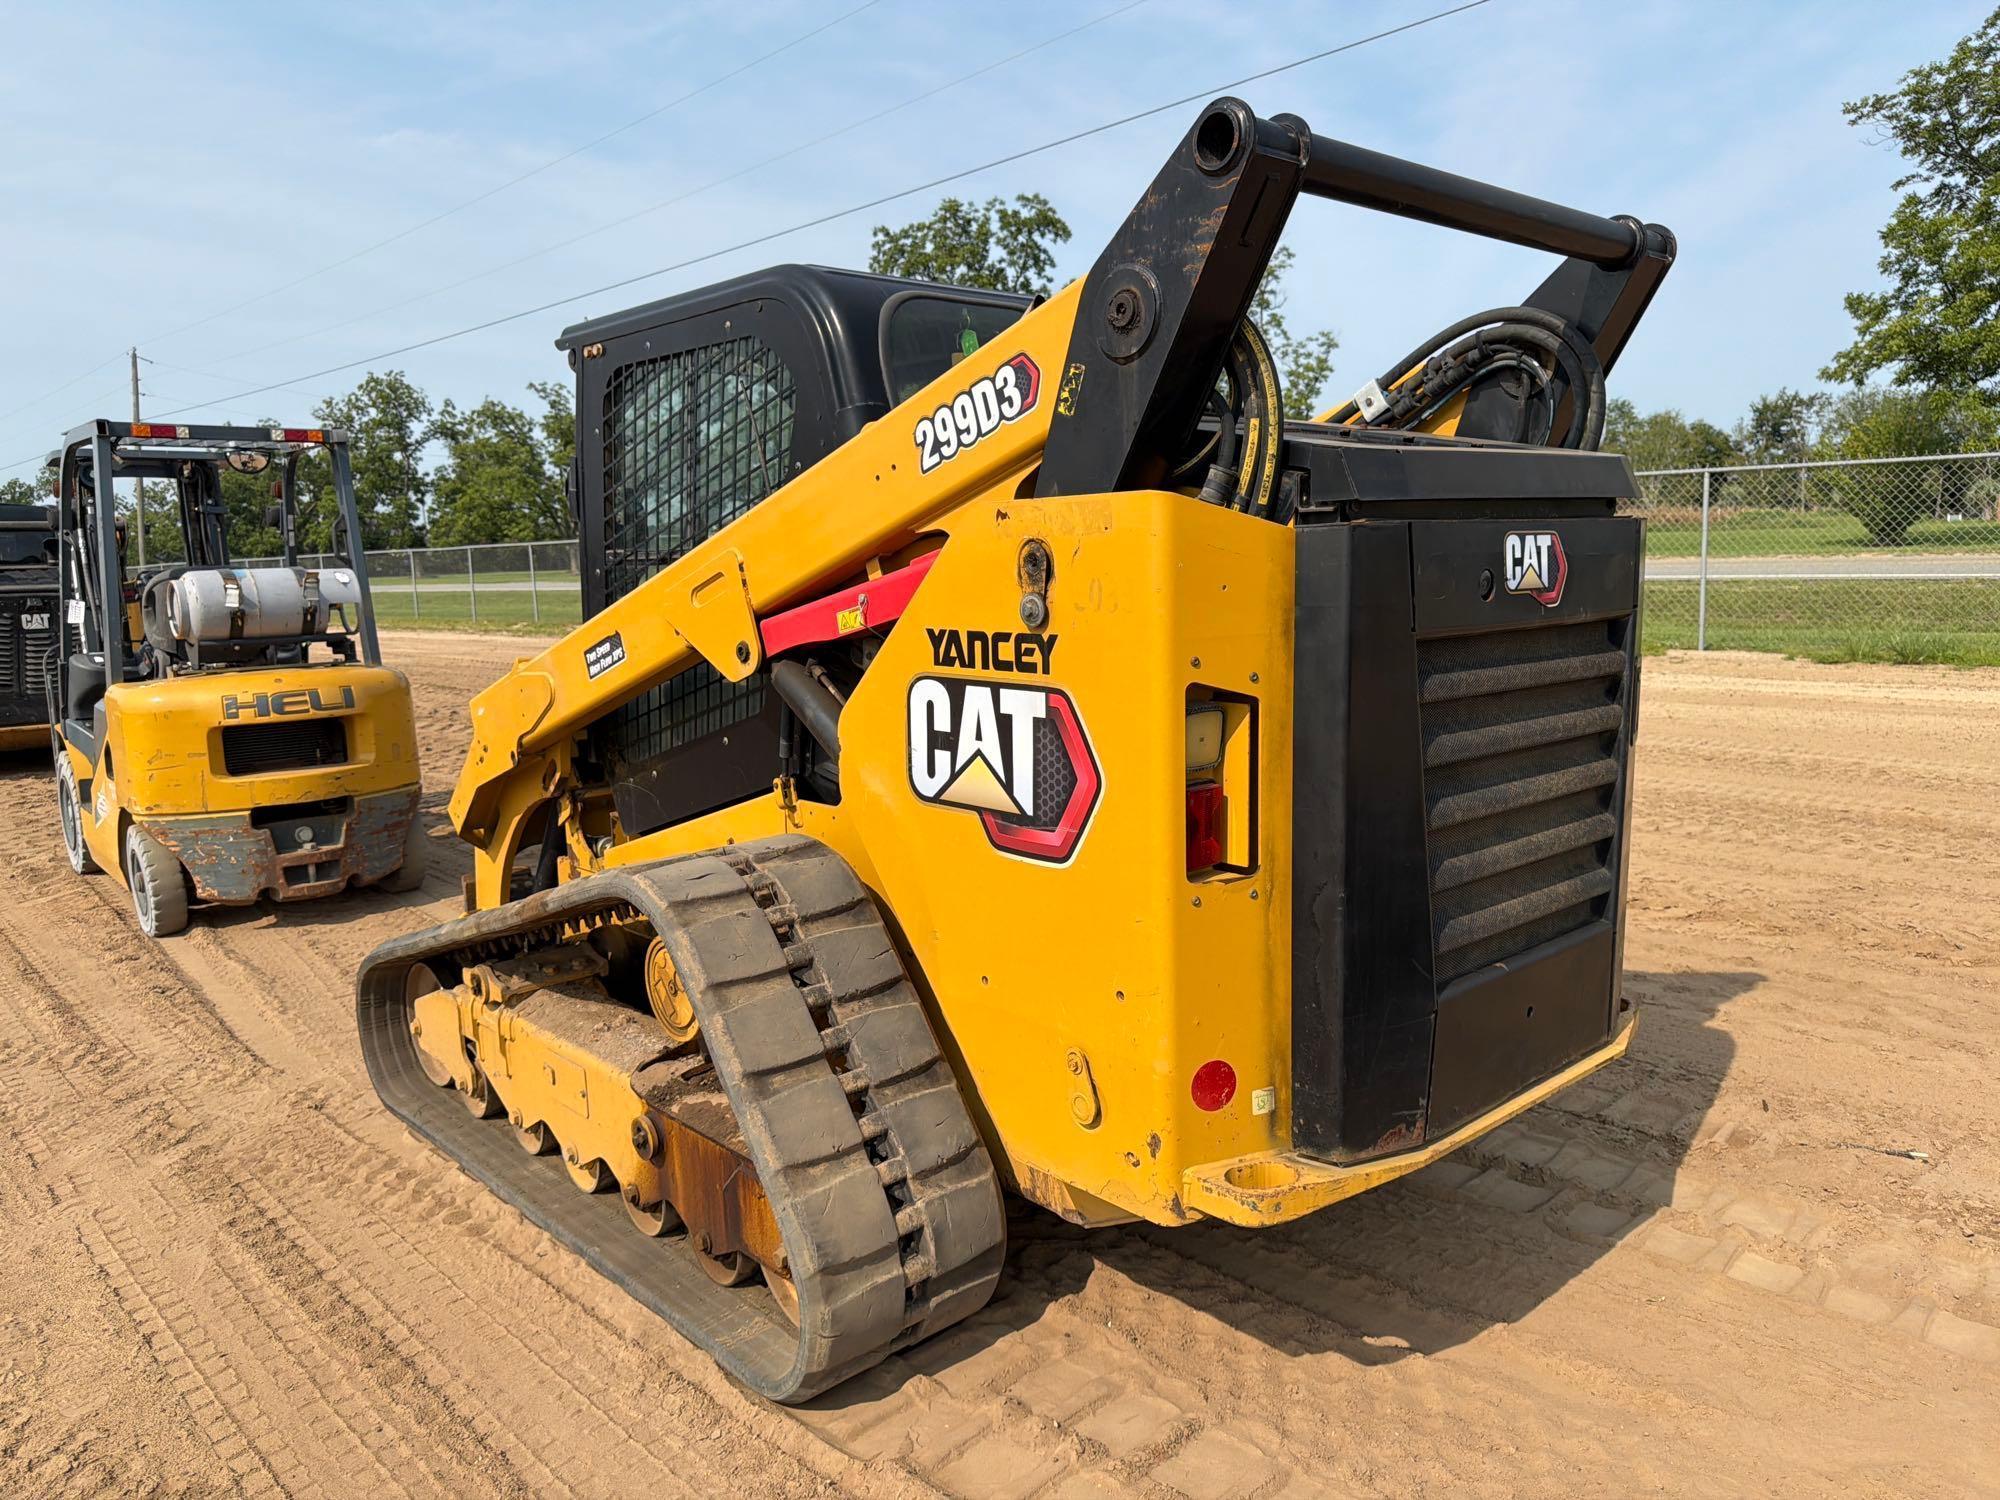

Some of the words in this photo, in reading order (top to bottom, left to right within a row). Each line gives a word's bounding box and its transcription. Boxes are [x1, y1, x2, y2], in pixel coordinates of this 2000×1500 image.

[914, 364, 1023, 471] 299D3
[1505, 534, 1552, 590] CAT
[20, 612, 51, 629] CAT
[925, 627, 1059, 676] YANCEY
[222, 685, 356, 720] HELI
[909, 678, 1047, 817] CAT
